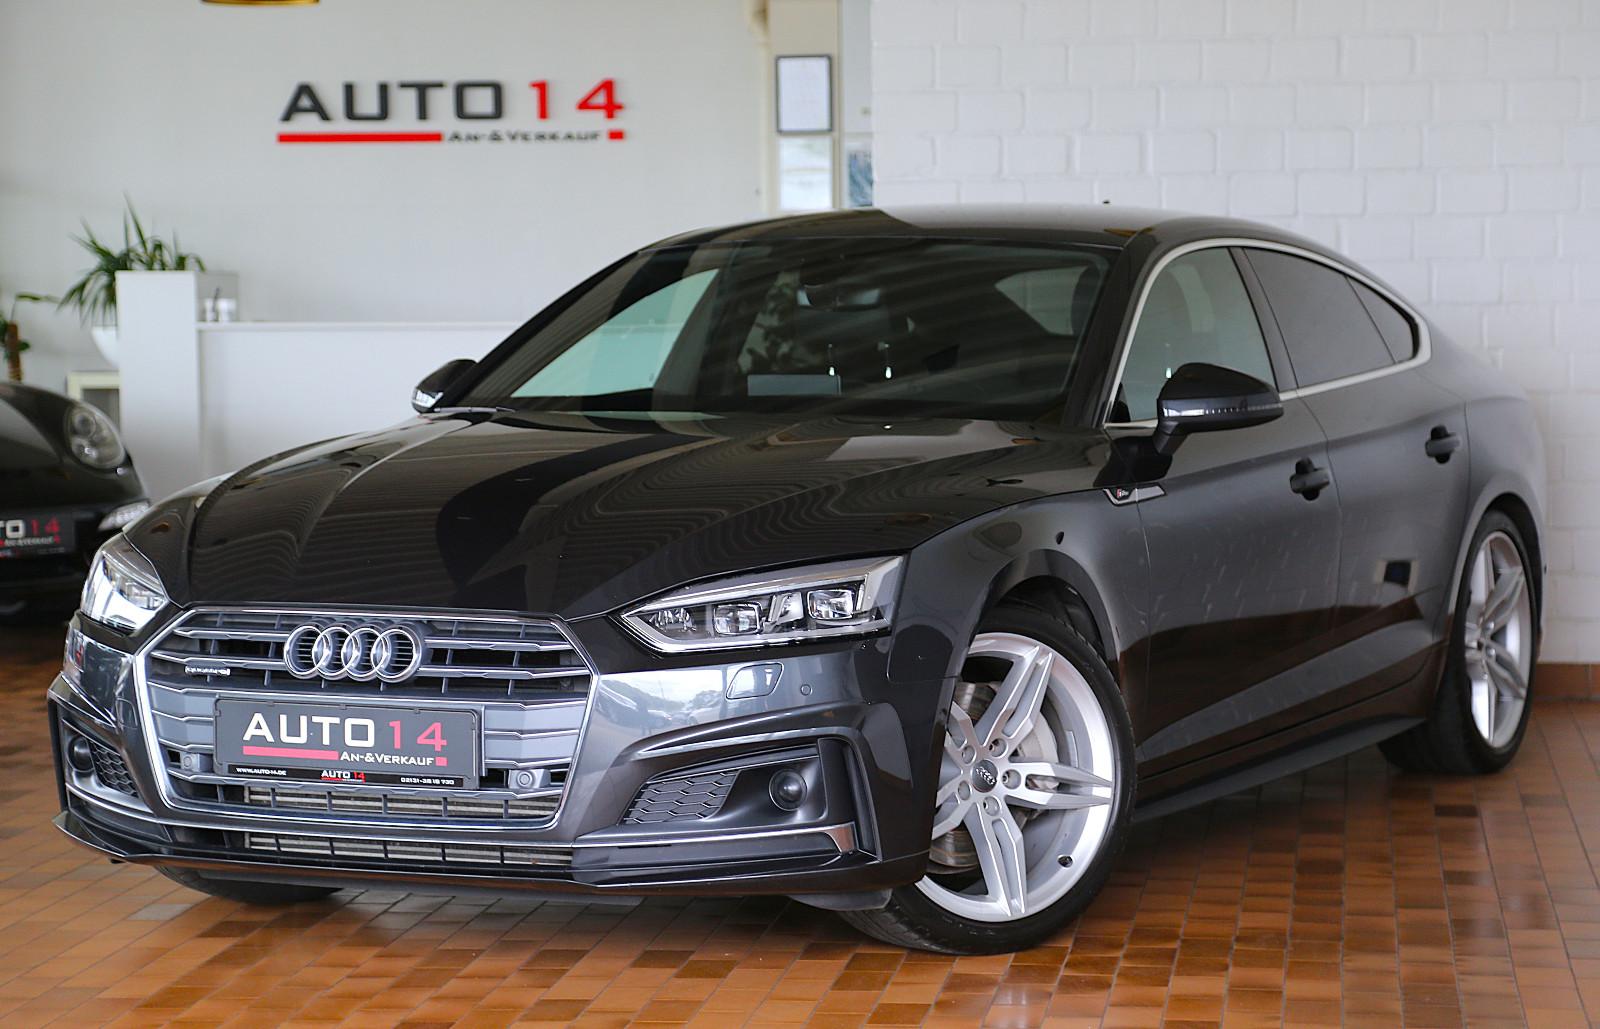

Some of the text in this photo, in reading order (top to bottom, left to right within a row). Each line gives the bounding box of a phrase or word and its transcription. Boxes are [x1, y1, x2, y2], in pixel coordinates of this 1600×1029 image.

[280, 80, 625, 121] AUTO 14
[242, 712, 447, 751] AUTO 14
[321, 769, 351, 779] AUTO
